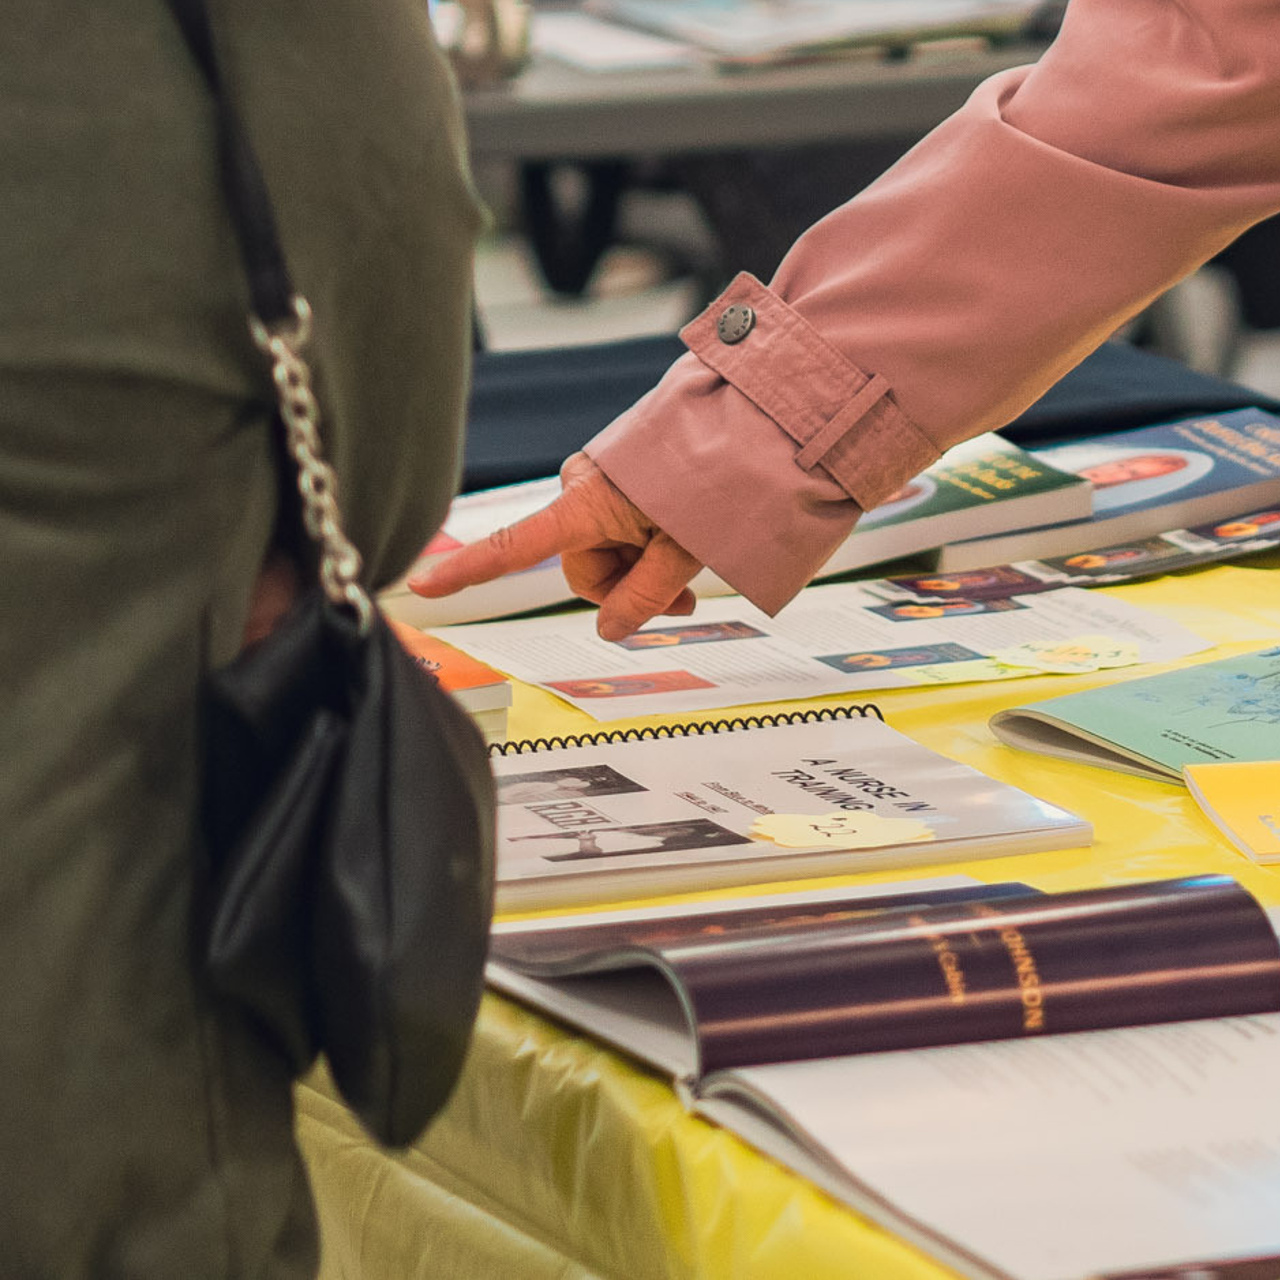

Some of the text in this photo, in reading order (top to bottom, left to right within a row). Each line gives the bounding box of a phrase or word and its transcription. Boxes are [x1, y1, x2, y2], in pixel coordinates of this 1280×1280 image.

[770, 769, 874, 811] TRAINING
[801, 758, 938, 812] A NURSE IN
[997, 924, 1045, 1029] OHNSON
